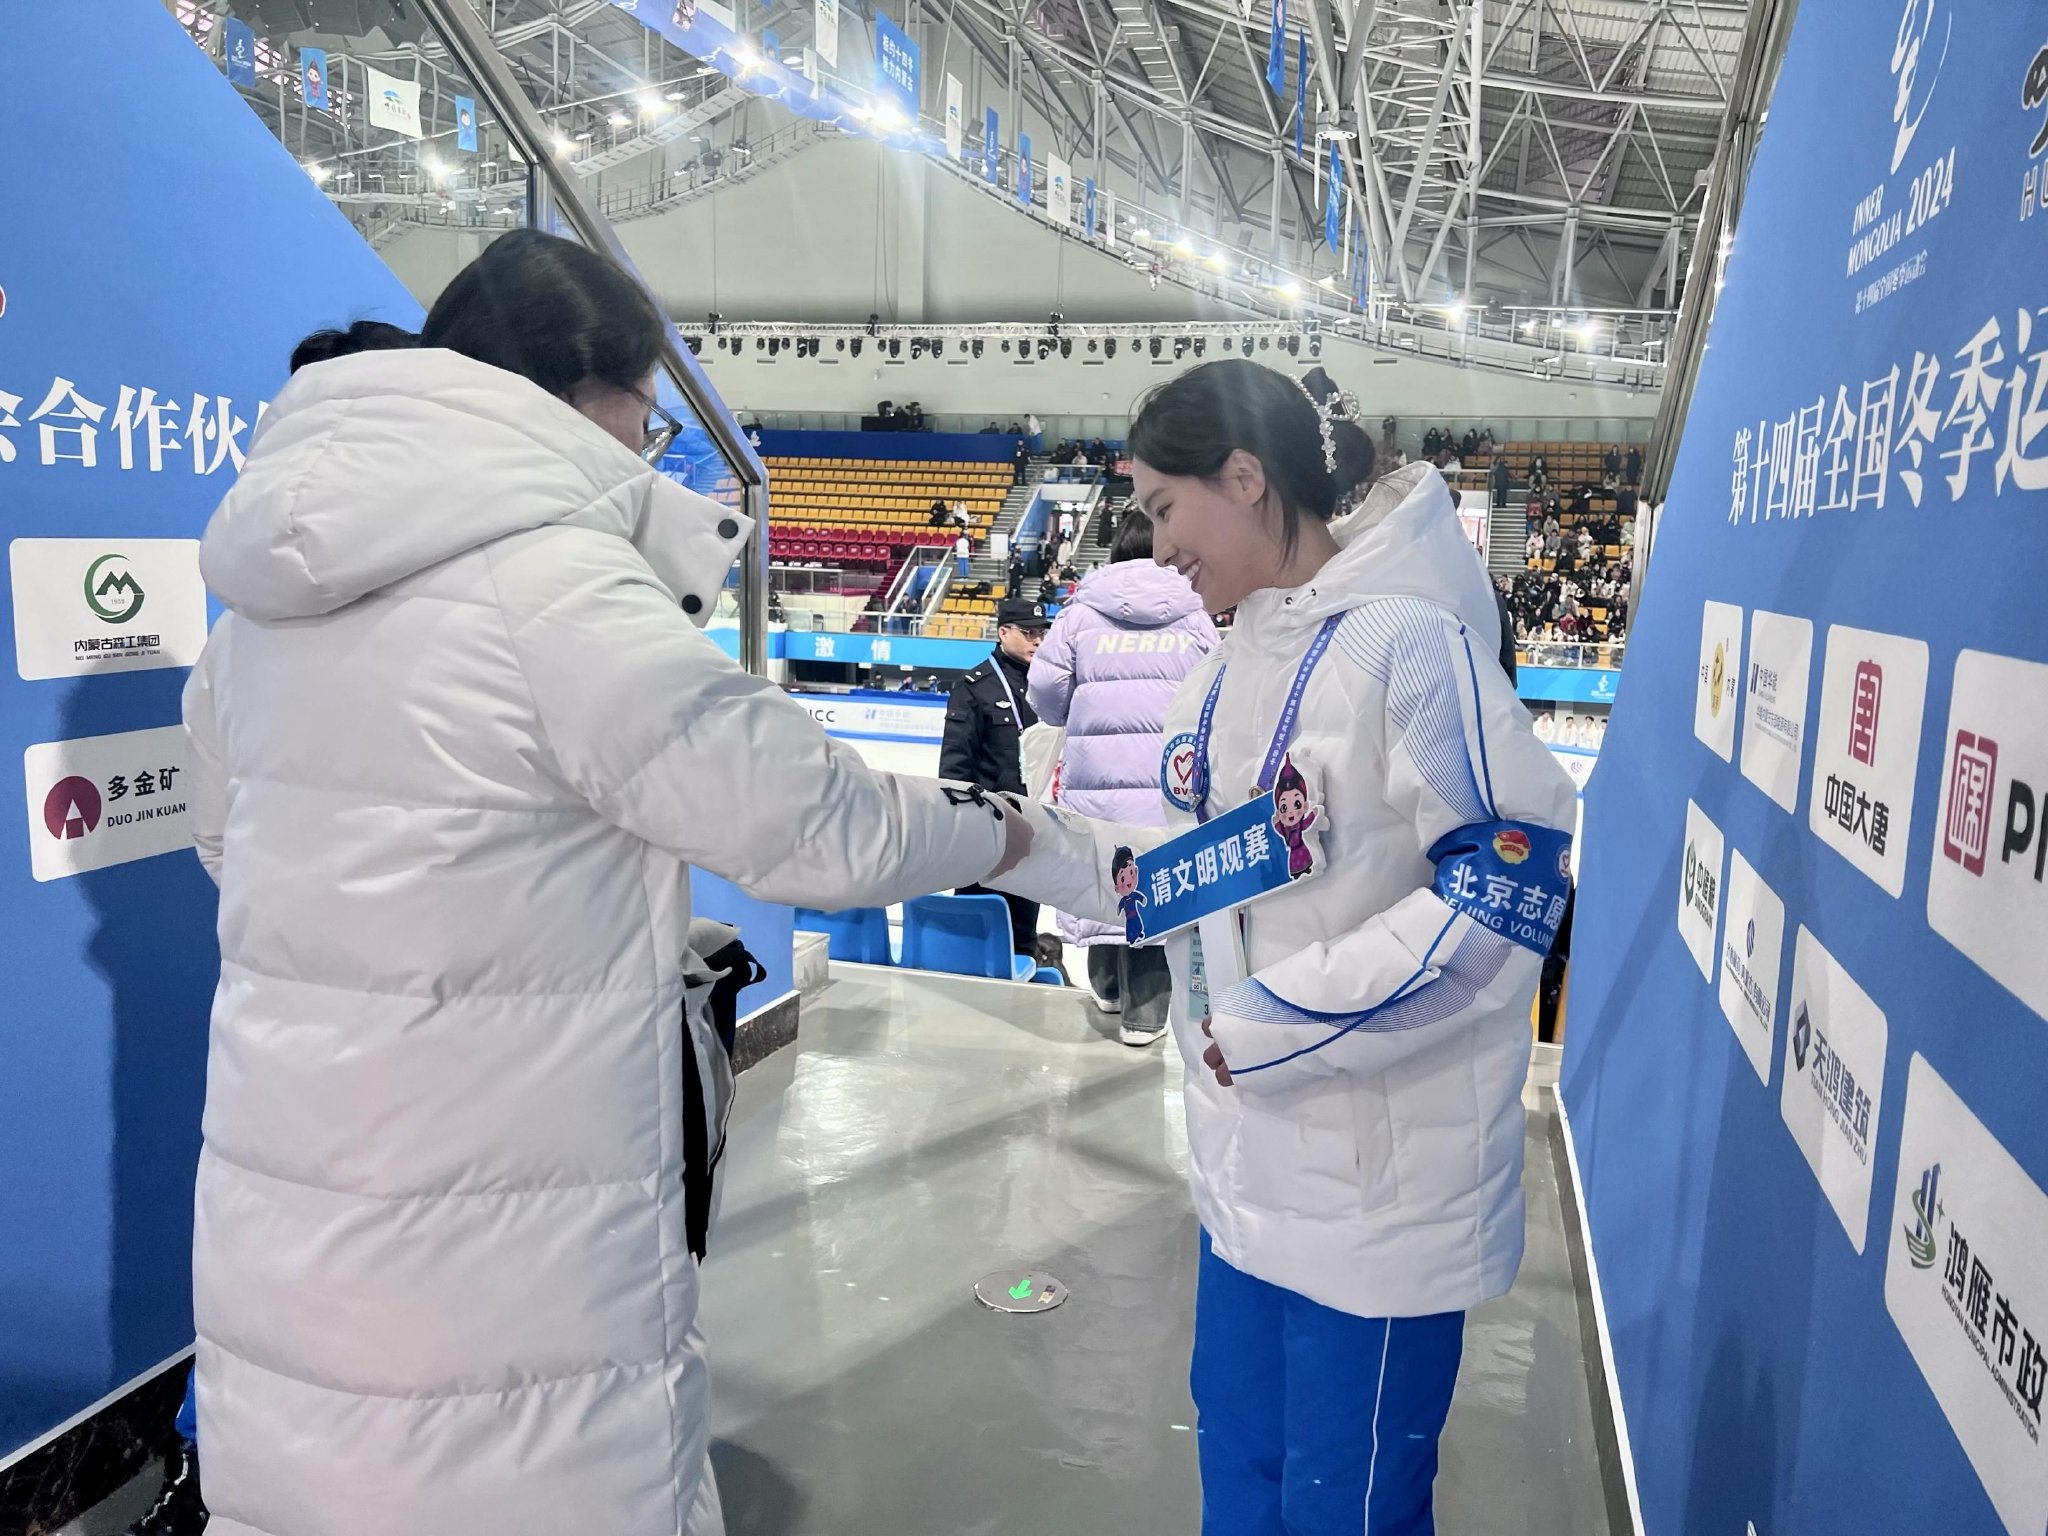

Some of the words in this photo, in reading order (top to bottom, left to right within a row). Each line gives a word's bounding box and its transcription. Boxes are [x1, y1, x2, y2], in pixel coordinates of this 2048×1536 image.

[1847, 209, 1902, 279] MONGOLIA
[1906, 145, 1955, 236] 2024
[1853, 184, 1884, 236] INNER
[74, 634, 160, 652] 内蒙古森工集团
[1095, 631, 1196, 655] NERDY
[107, 766, 180, 802] 多金矿
[108, 813, 132, 827] DUO
[135, 809, 153, 822] JIN
[1824, 773, 1889, 857] 中国大唐
[1151, 822, 1270, 907] 请文明观赛
[1811, 1071, 1822, 1100] TIAN
[1822, 1090, 1839, 1123] HONG
[1840, 1118, 1853, 1146] JIAN
[1853, 1138, 1868, 1166] ZHU
[1812, 1028, 1872, 1145] 天鸿建筑
[1942, 1283, 1964, 1327] HONGYAN
[1964, 1319, 1990, 1371] MUNICIPAL
[1990, 1363, 2039, 1446] ADMINISTRATION
[1944, 1221, 2048, 1425] 鸿雁市政
